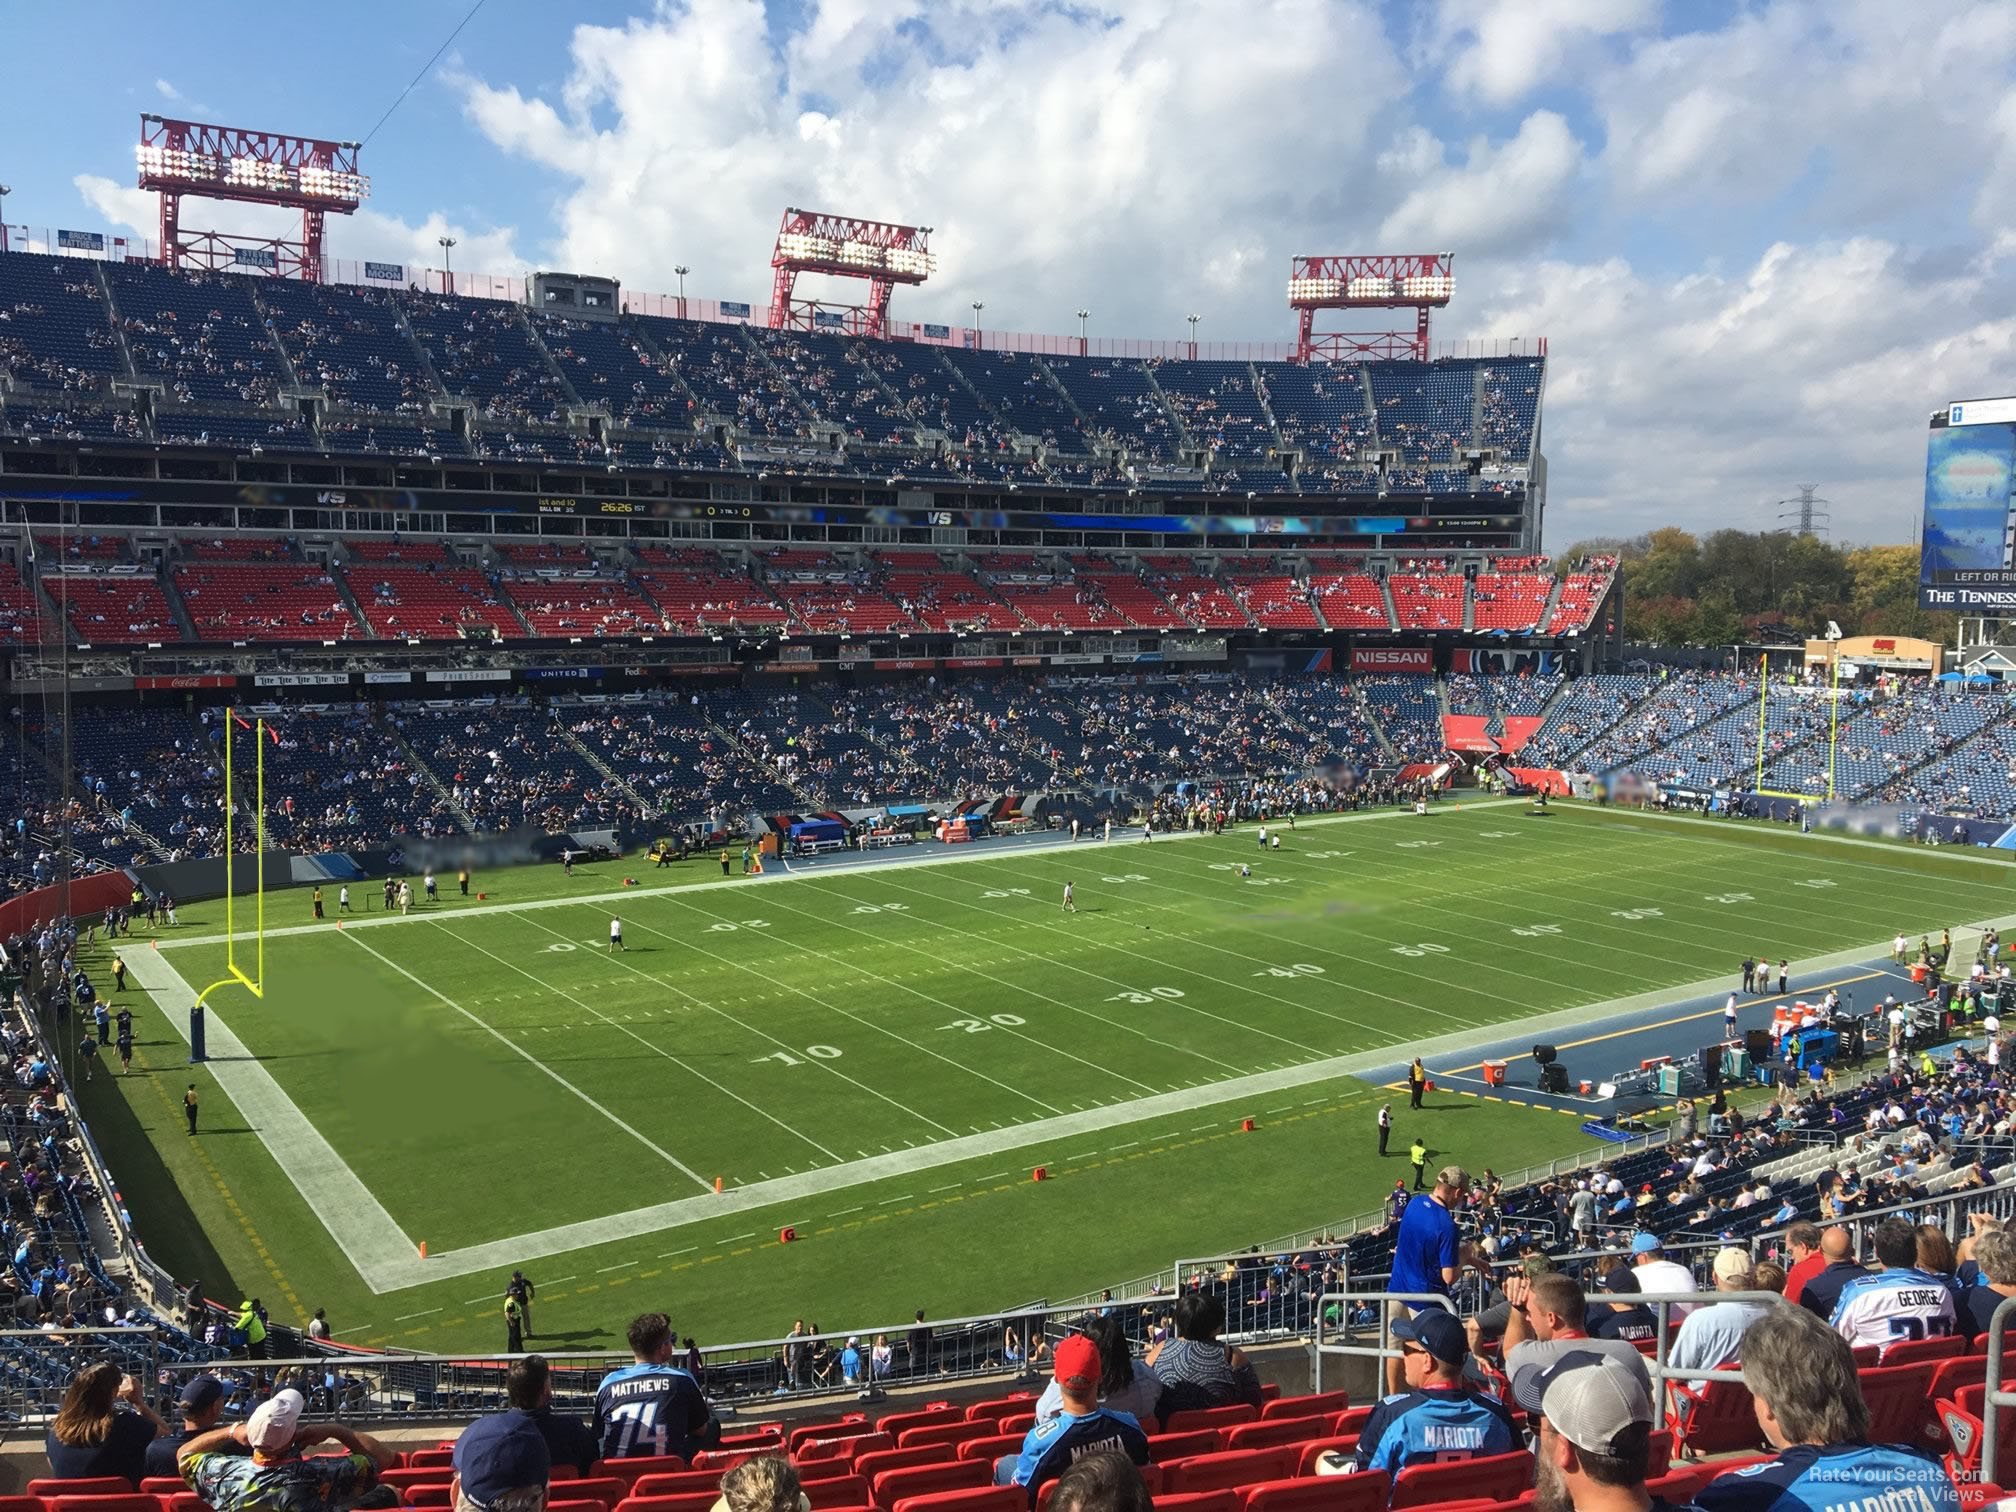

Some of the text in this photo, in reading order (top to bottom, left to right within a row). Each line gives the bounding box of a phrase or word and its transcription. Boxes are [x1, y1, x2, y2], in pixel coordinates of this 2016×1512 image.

[68, 232, 93, 240] BRUCE
[60, 238, 102, 250] MATTHEWS
[242, 250, 269, 259] STEVE
[238, 256, 273, 267] McNAIR
[367, 269, 401, 280] MOON
[317, 491, 346, 504] VS
[600, 502, 632, 513] 26:26
[707, 506, 715, 516] 0
[742, 507, 750, 517] 0
[927, 512, 952, 525] VS
[1955, 572, 1981, 581] LEFT
[1983, 572, 1999, 581] OR
[1926, 589, 1956, 603] THE
[1355, 651, 1428, 664] NISSAN
[839, 662, 855, 670] CMT
[895, 660, 915, 669] xfinity
[624, 667, 648, 676] FedEx
[259, 675, 346, 685] Lite Lite Lite Lite Lite
[1389, 943, 1451, 957] 50
[1266, 963, 1326, 979] 40
[1117, 987, 1185, 1004] 30
[951, 1013, 1027, 1034] 20
[769, 1045, 843, 1067] 10
[1494, 1069, 1503, 1078] G
[1897, 1289, 1941, 1307] GEORGE
[1618, 1324, 1655, 1340] MARIOTA
[611, 1378, 670, 1399] MATTHEWS
[605, 1401, 668, 1457] 74
[1424, 1425, 1485, 1449] MARIOTA
[1824, 1485, 1937, 1512] IOTA
